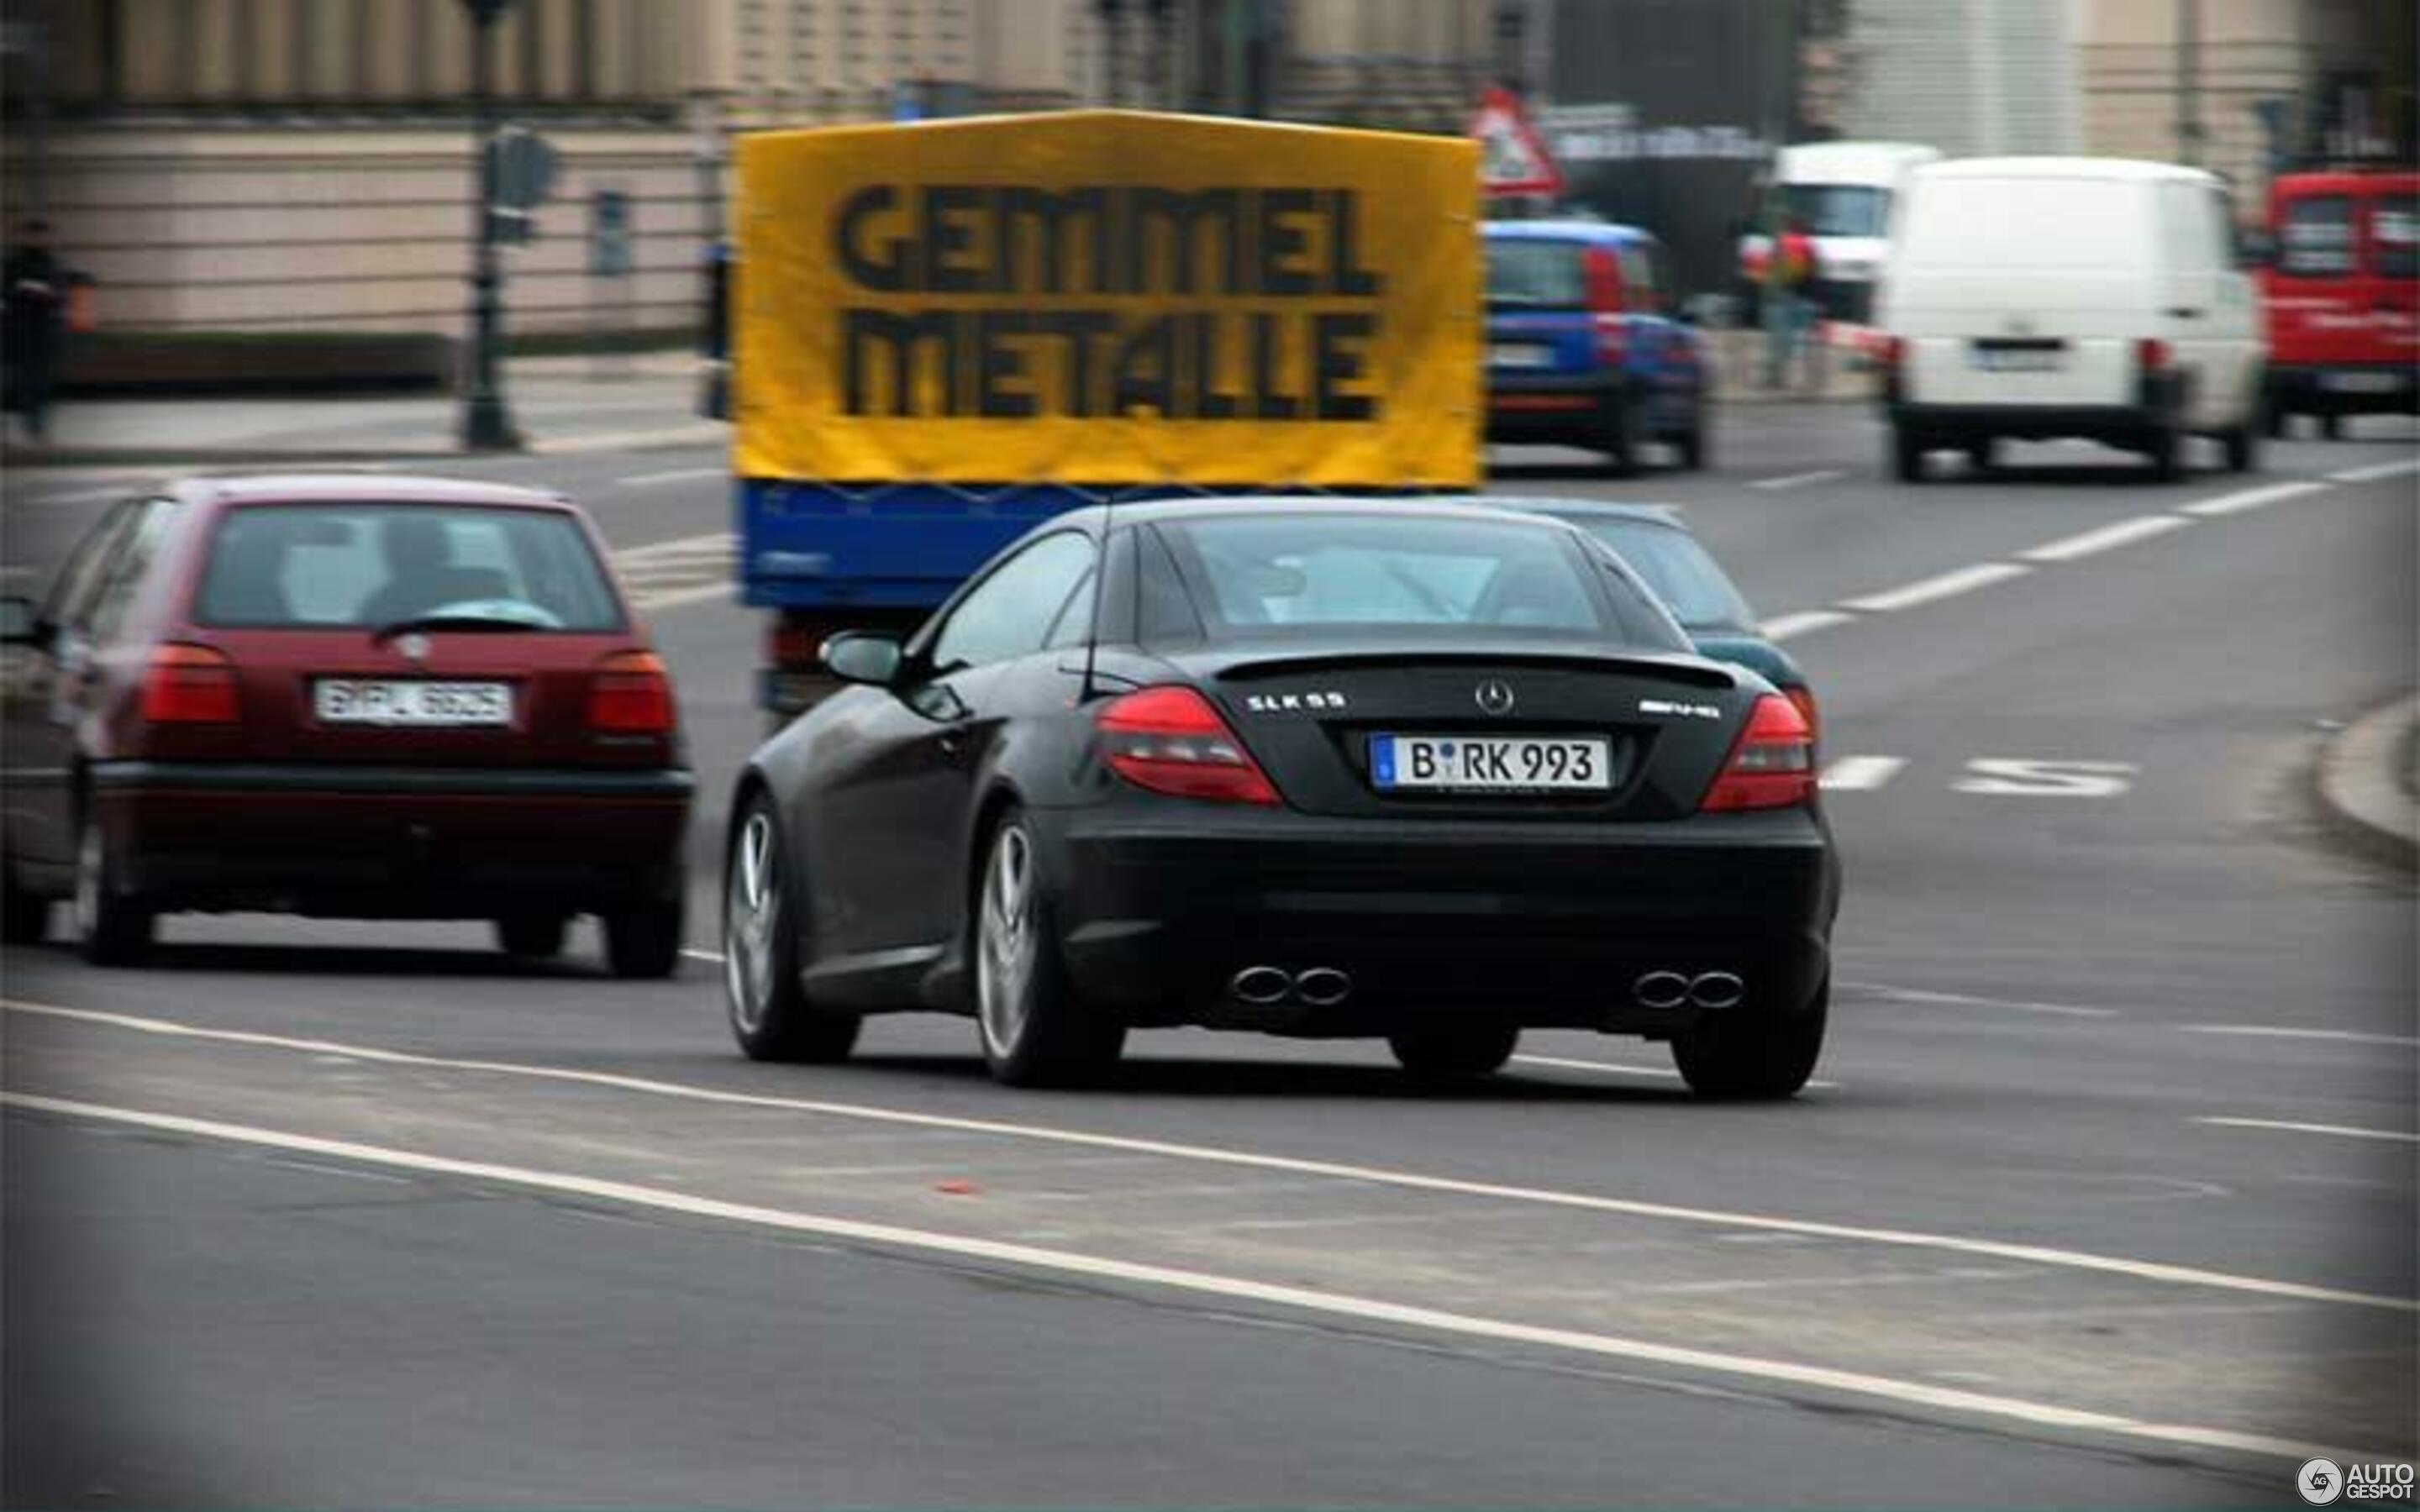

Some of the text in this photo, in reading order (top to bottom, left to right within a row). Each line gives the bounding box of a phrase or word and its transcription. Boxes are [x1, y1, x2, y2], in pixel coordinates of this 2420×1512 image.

[834, 184, 1386, 296] GEMMEL
[840, 307, 1380, 422] METALLE
[1412, 743, 1593, 781] B RK 993
